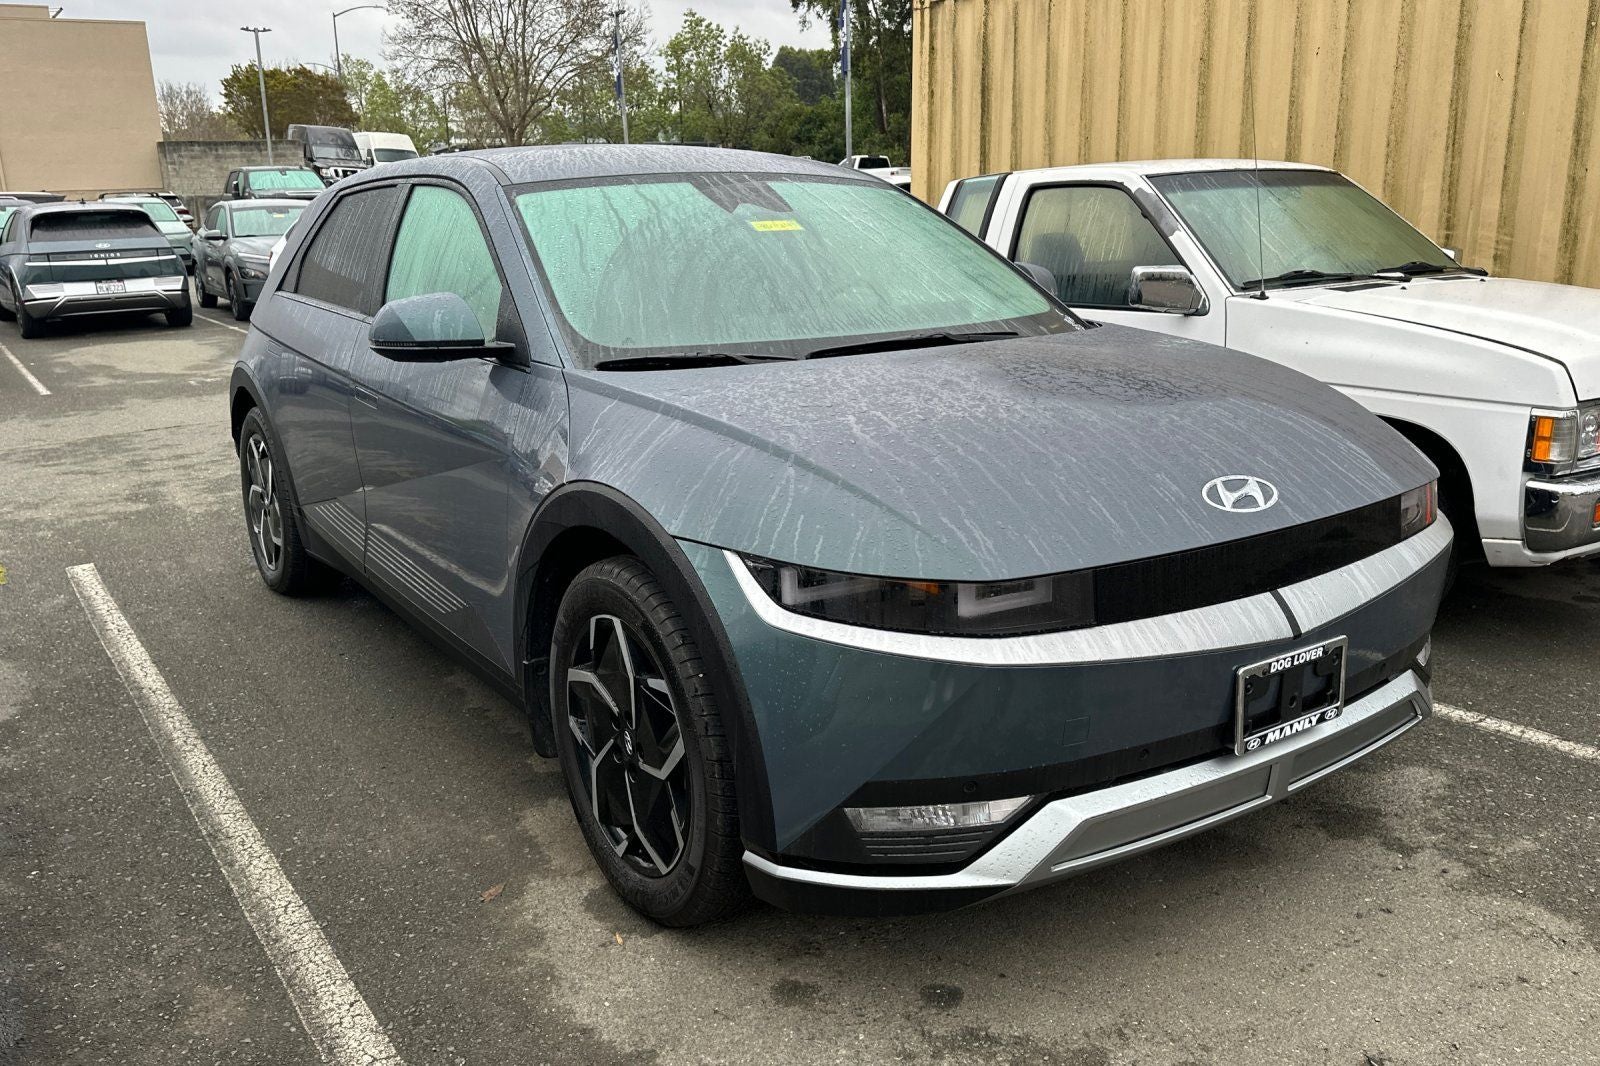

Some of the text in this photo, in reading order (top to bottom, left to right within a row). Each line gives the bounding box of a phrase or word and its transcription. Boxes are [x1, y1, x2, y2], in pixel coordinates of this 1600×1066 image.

[1270, 647, 1324, 673] DOG LOVER
[1264, 714, 1321, 745] MANLY
